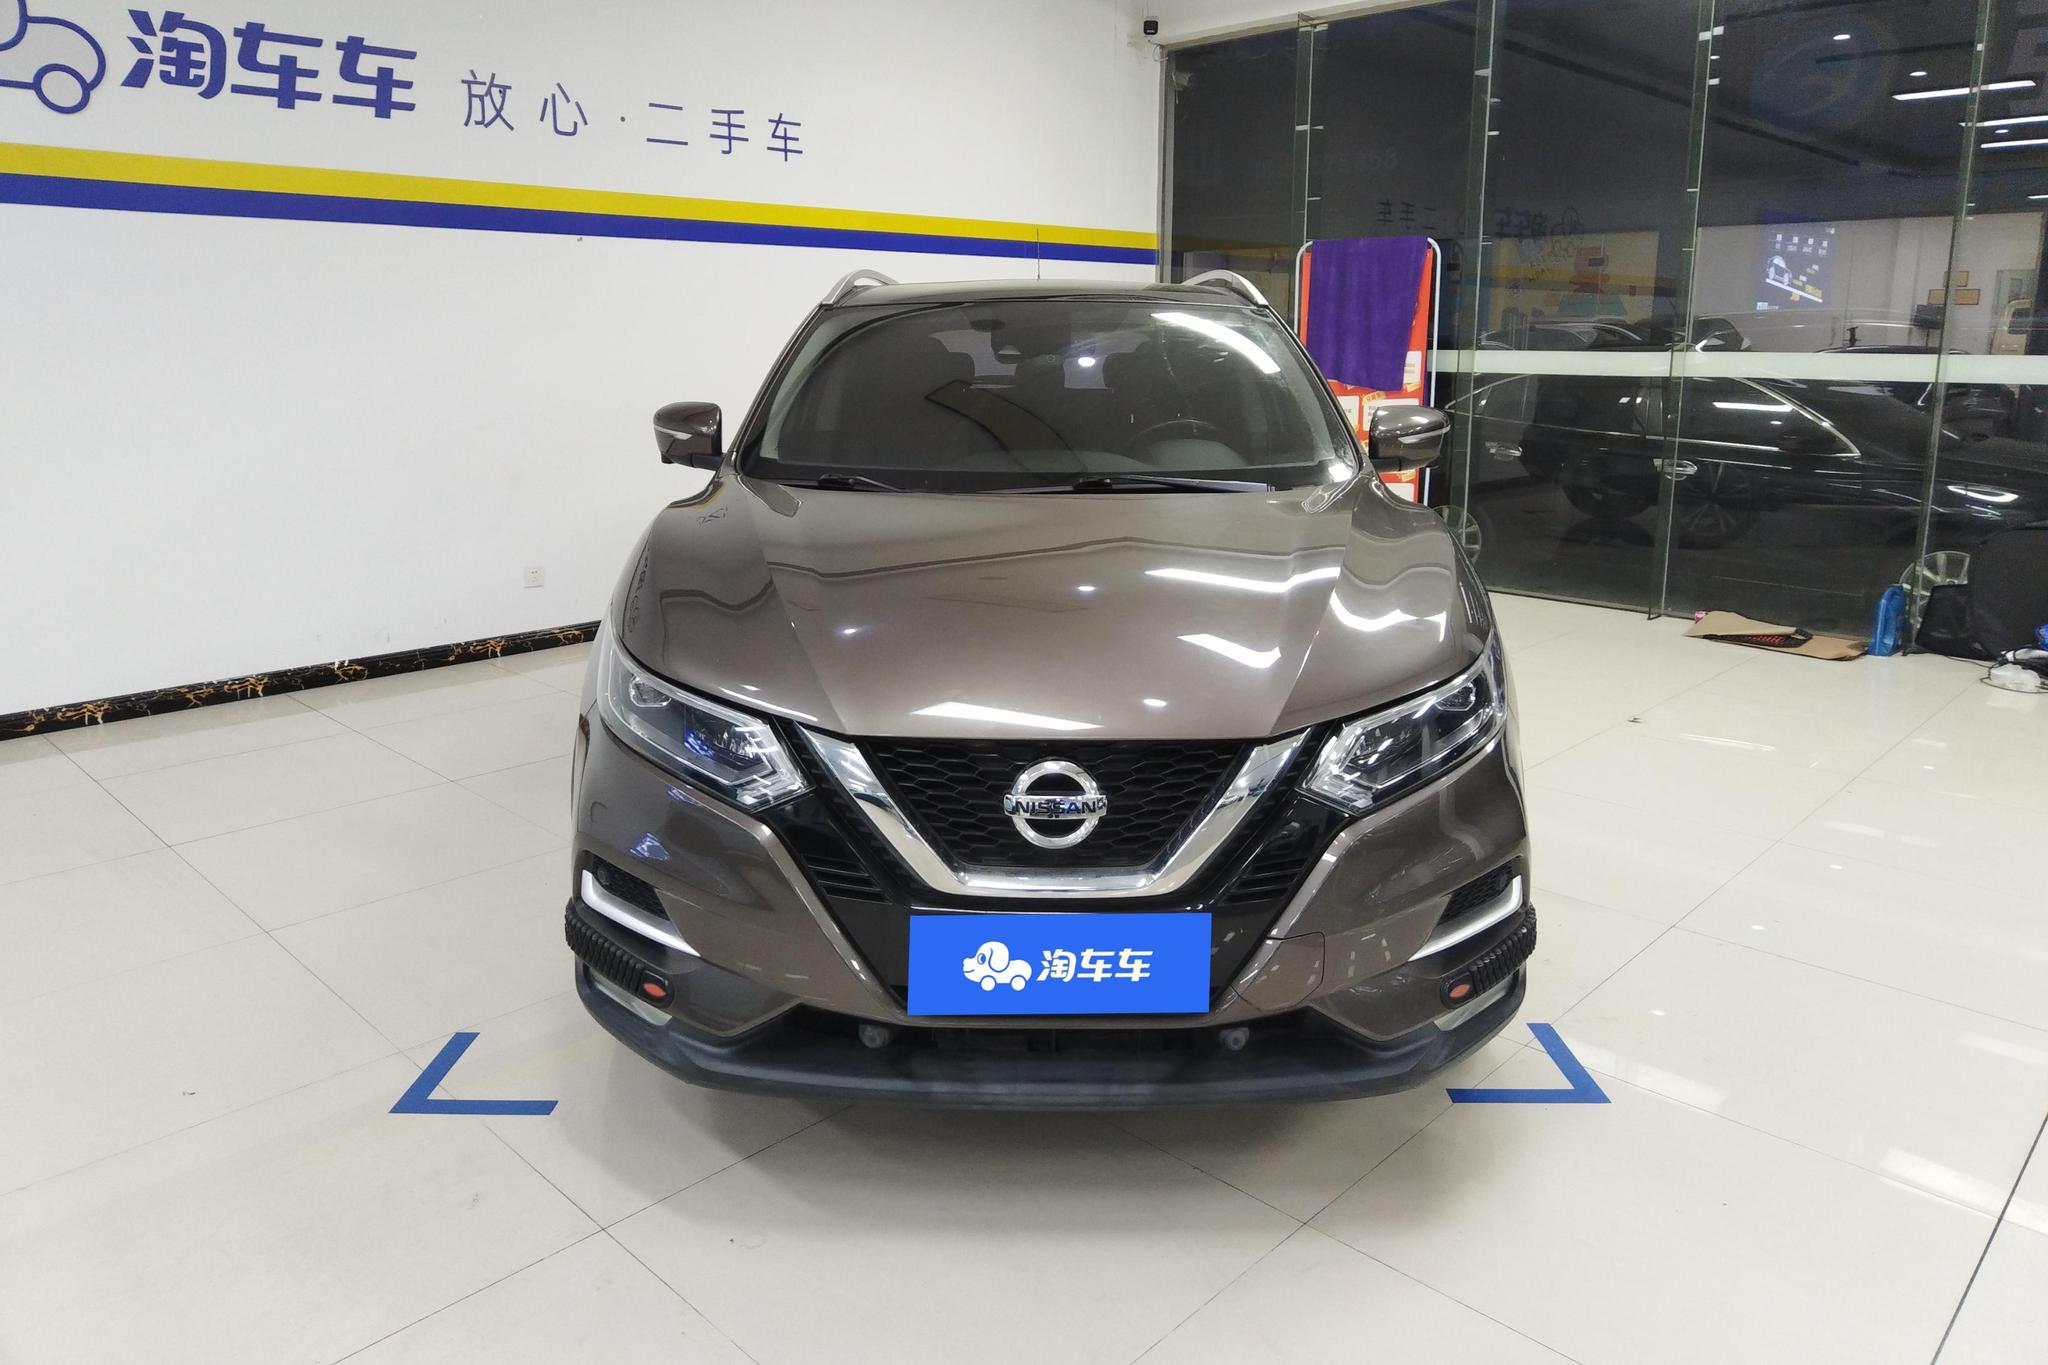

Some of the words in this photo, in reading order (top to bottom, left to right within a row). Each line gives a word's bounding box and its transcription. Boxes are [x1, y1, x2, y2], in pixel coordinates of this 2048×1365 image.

[121, 9, 418, 119] 淘车车
[1013, 799, 1099, 816] NISSAN
